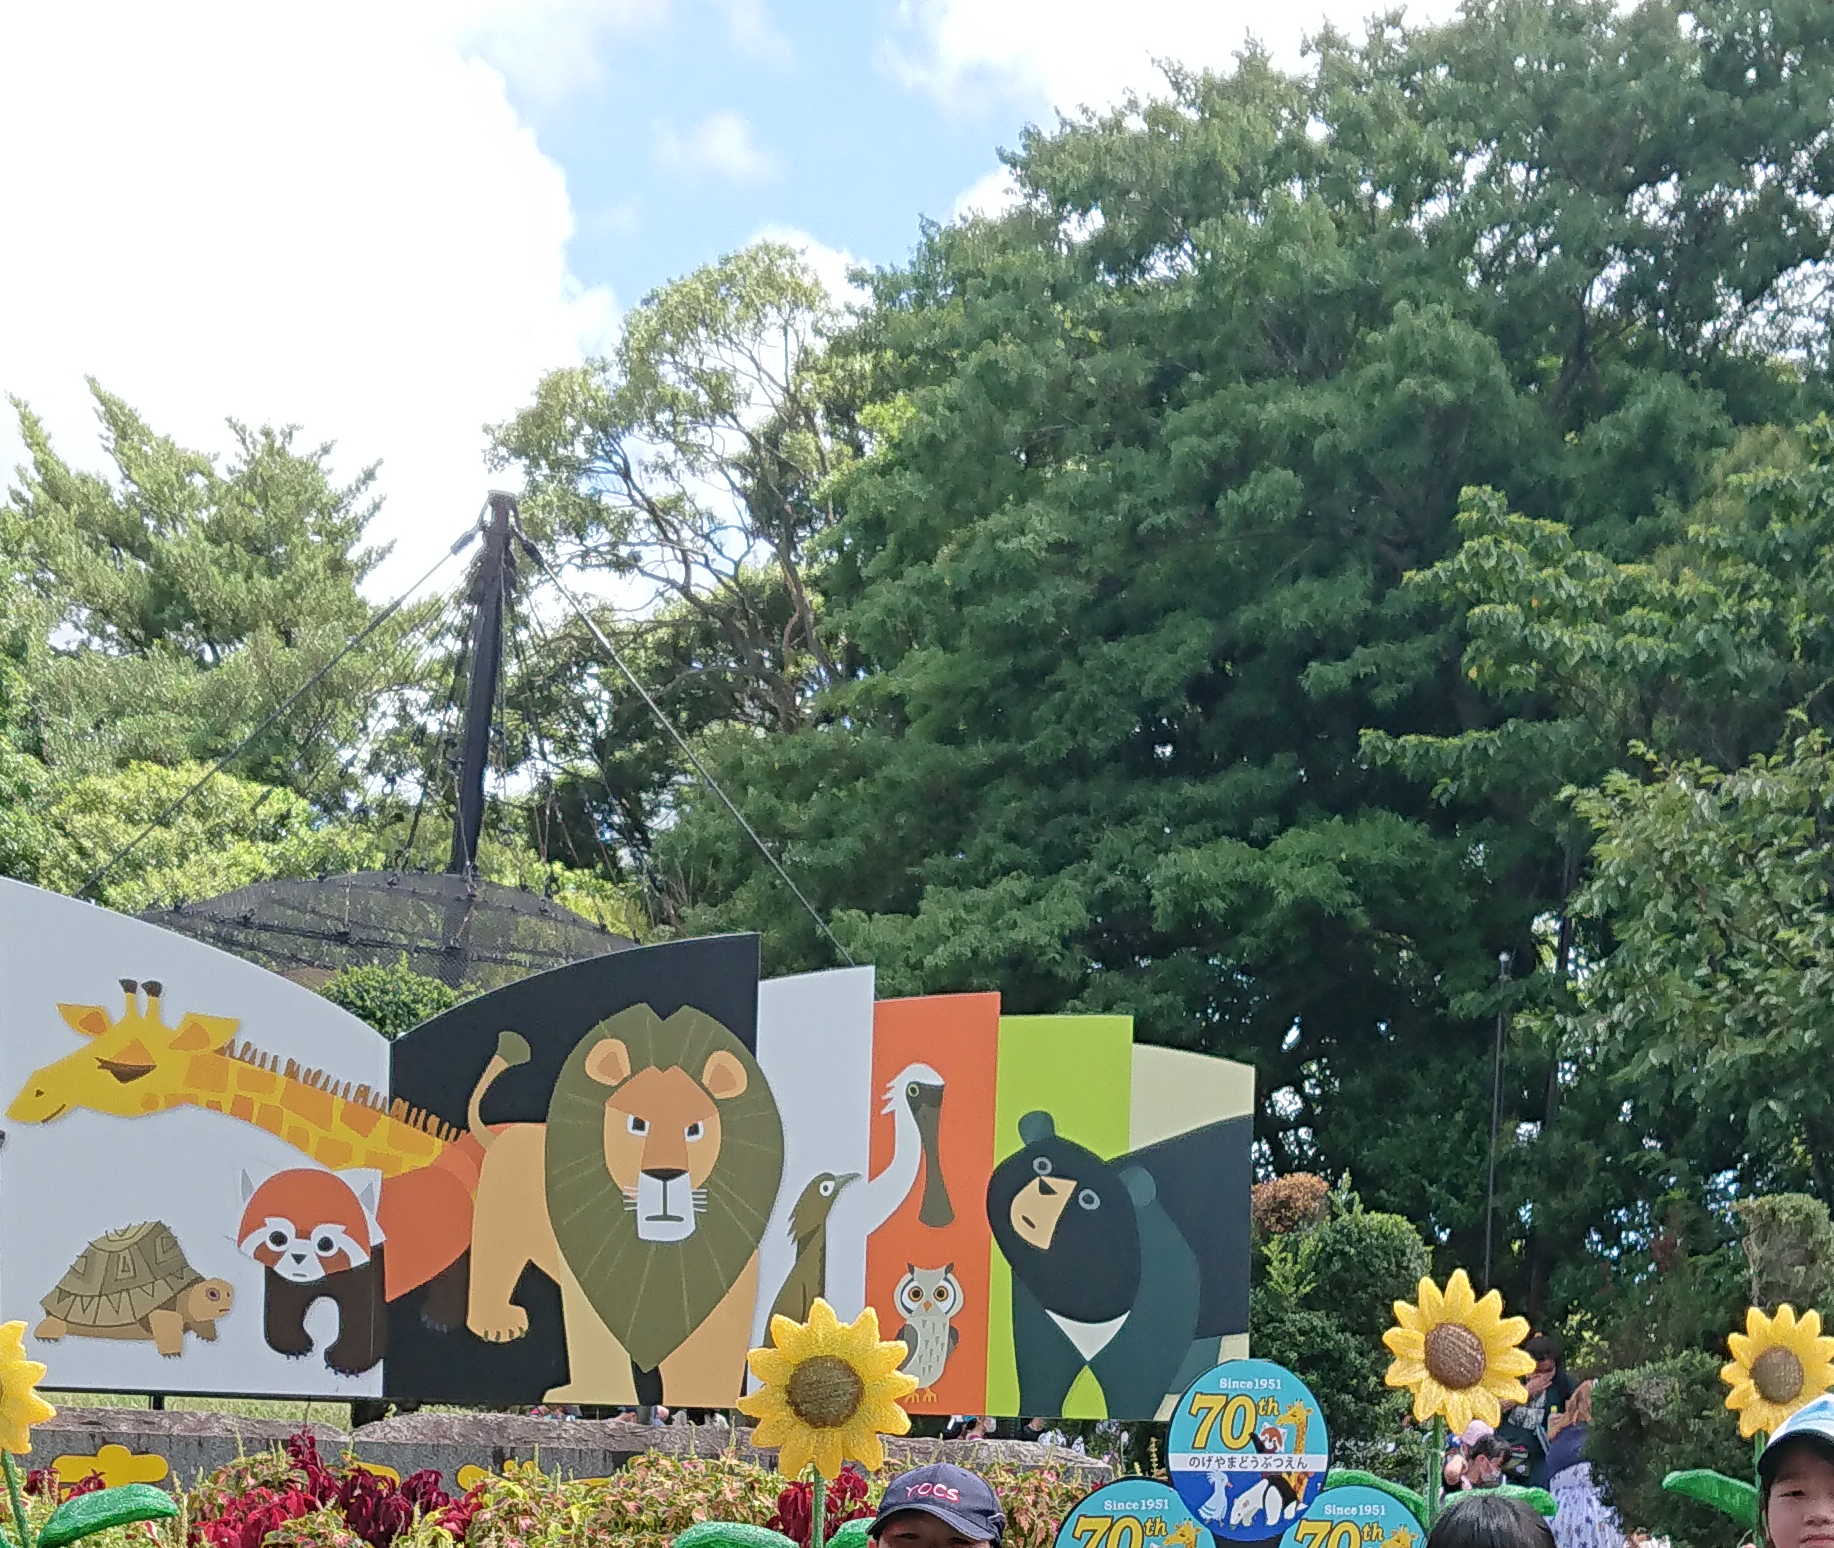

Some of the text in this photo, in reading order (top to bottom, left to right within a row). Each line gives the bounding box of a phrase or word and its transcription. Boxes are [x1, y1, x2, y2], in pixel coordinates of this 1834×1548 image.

[1189, 1456, 1308, 1470] のげやまどうぶつえん
[906, 1482, 960, 1502] YOCS
